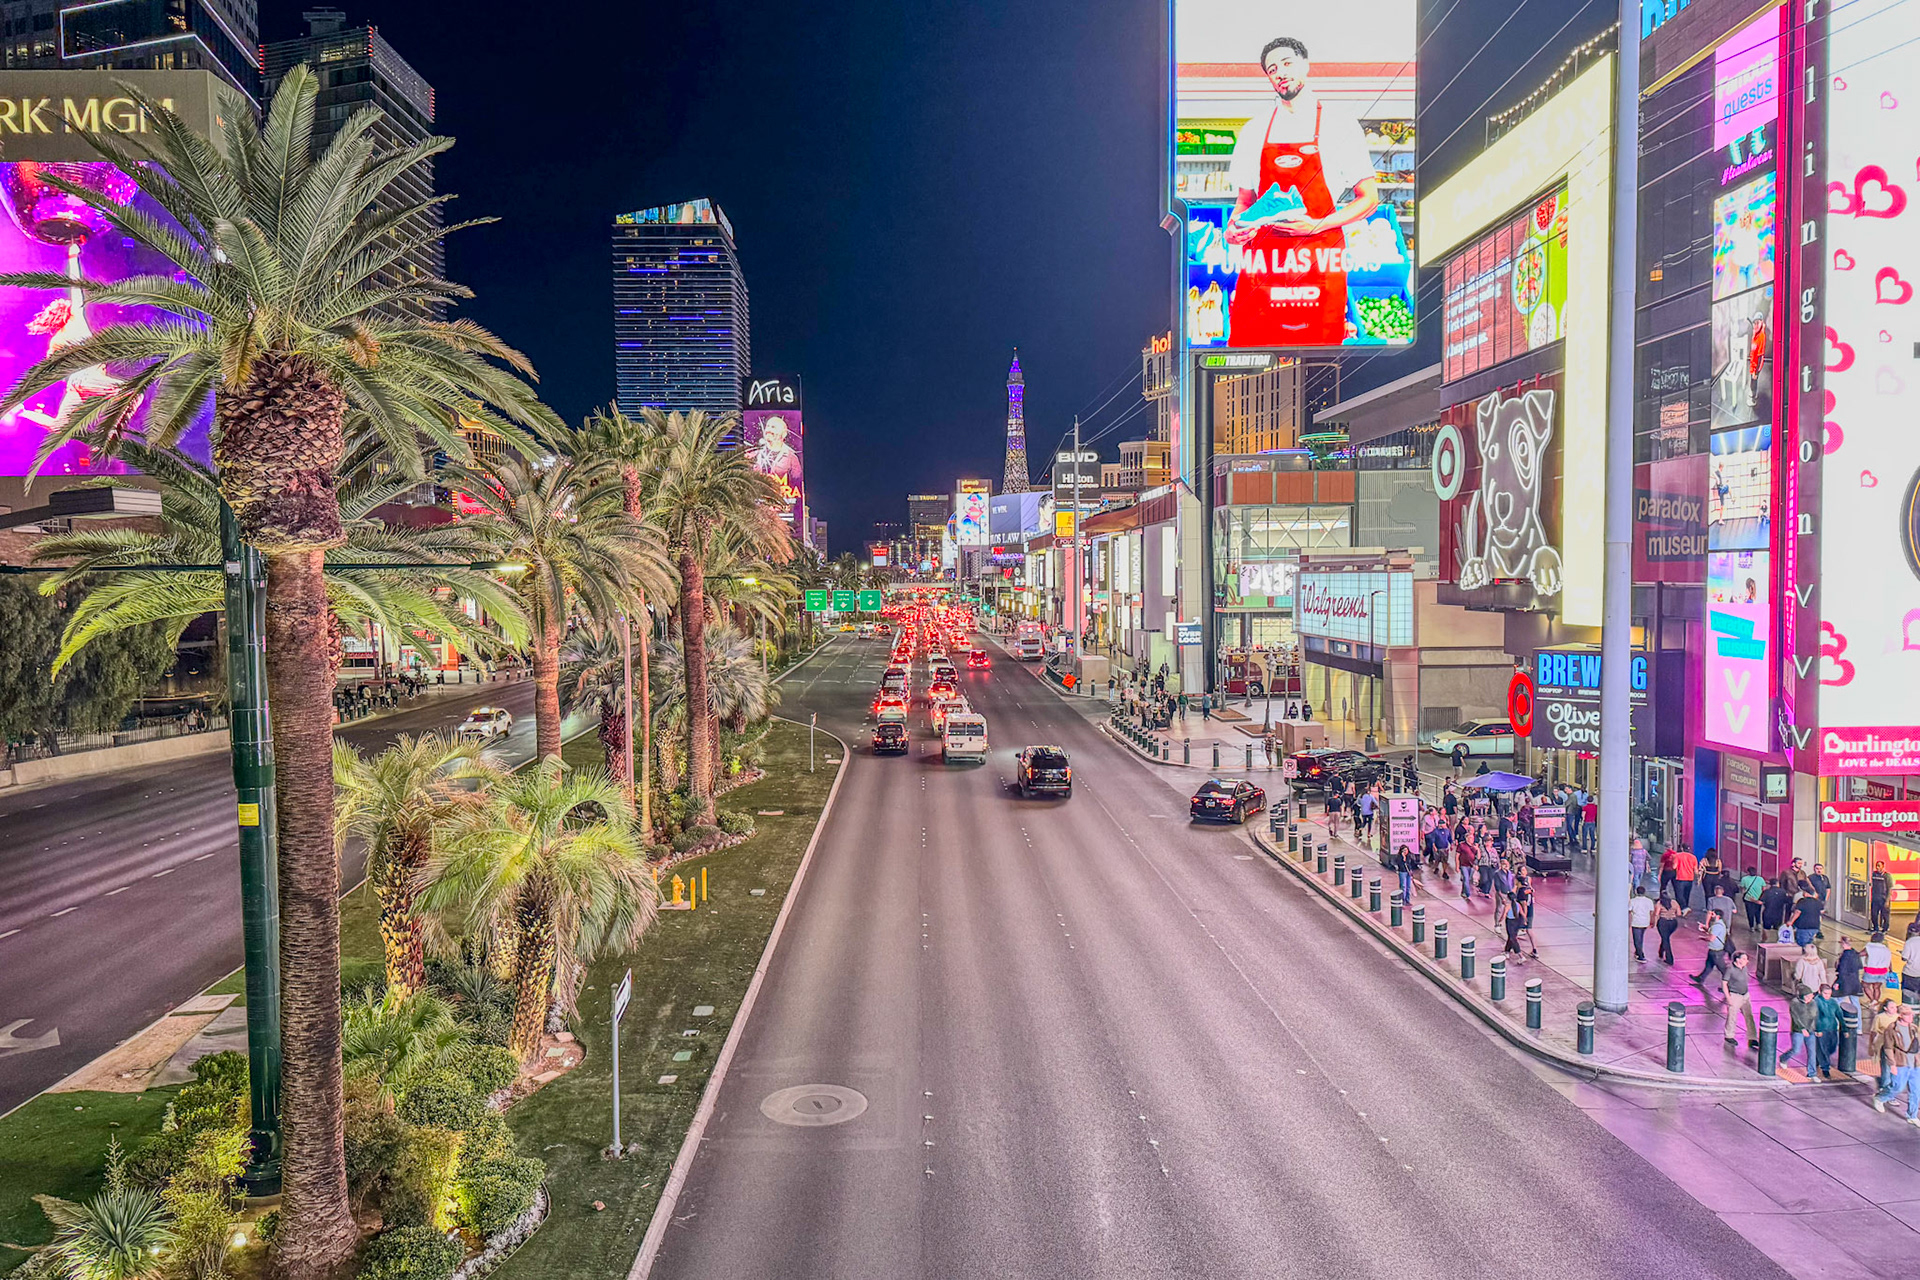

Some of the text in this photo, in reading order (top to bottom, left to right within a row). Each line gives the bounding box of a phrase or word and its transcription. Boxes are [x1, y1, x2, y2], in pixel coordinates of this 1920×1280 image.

[1723, 78, 1773, 125] guests
[1207, 248, 1382, 274] PUMA LAS VEGAS
[748, 380, 794, 405] Aria
[1062, 473, 1094, 483] Hiton
[1637, 496, 1701, 523] paradox
[1131, 543, 1141, 585] PANDORA
[1302, 580, 1368, 627] Walgreens
[1711, 615, 1754, 640] paradox
[1718, 641, 1764, 659] museum
[1538, 653, 1647, 690] BREWG
[1546, 702, 1600, 726] Olive
[1726, 758, 1751, 774] paradox
[1838, 757, 1920, 768] LOVE the DEALS
[1730, 773, 1757, 787] museum
[1823, 806, 1919, 828] Burlington
